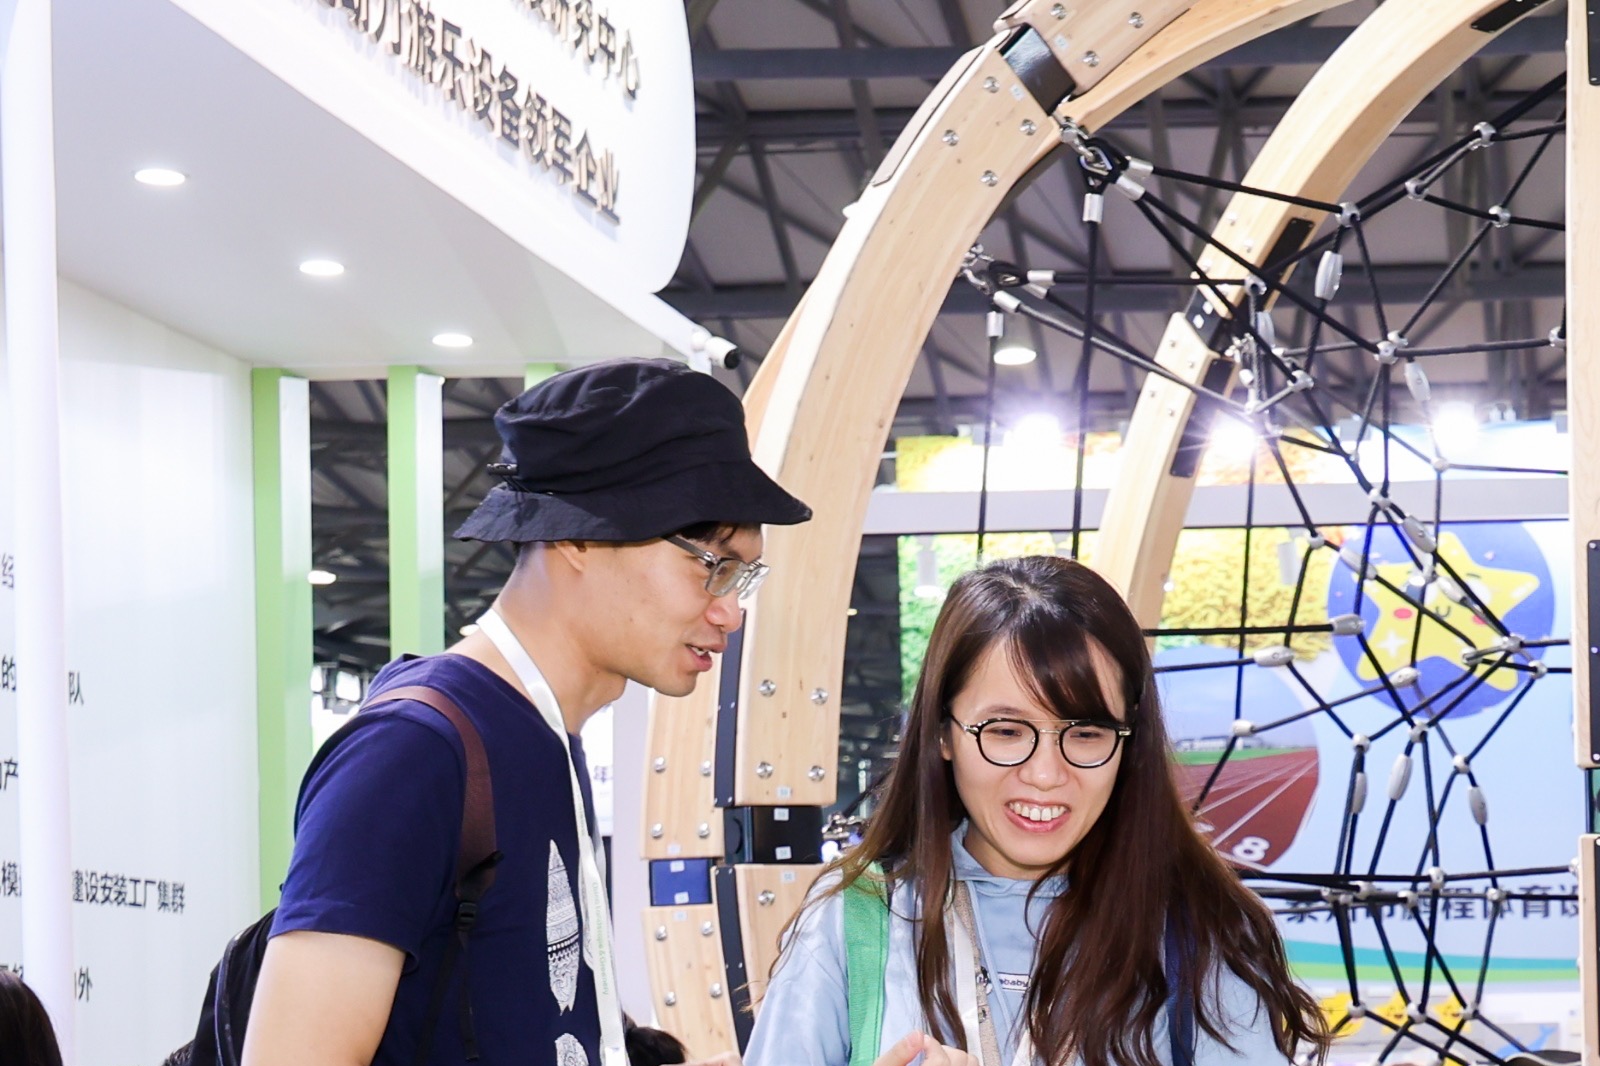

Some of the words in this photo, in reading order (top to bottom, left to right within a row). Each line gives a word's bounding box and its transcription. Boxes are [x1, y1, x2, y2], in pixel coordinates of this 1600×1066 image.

[330, 0, 621, 226] 力游乐设备领军企业
[0, 757, 18, 791] 产
[1232, 835, 1271, 863] 8
[74, 966, 93, 1003] 外
